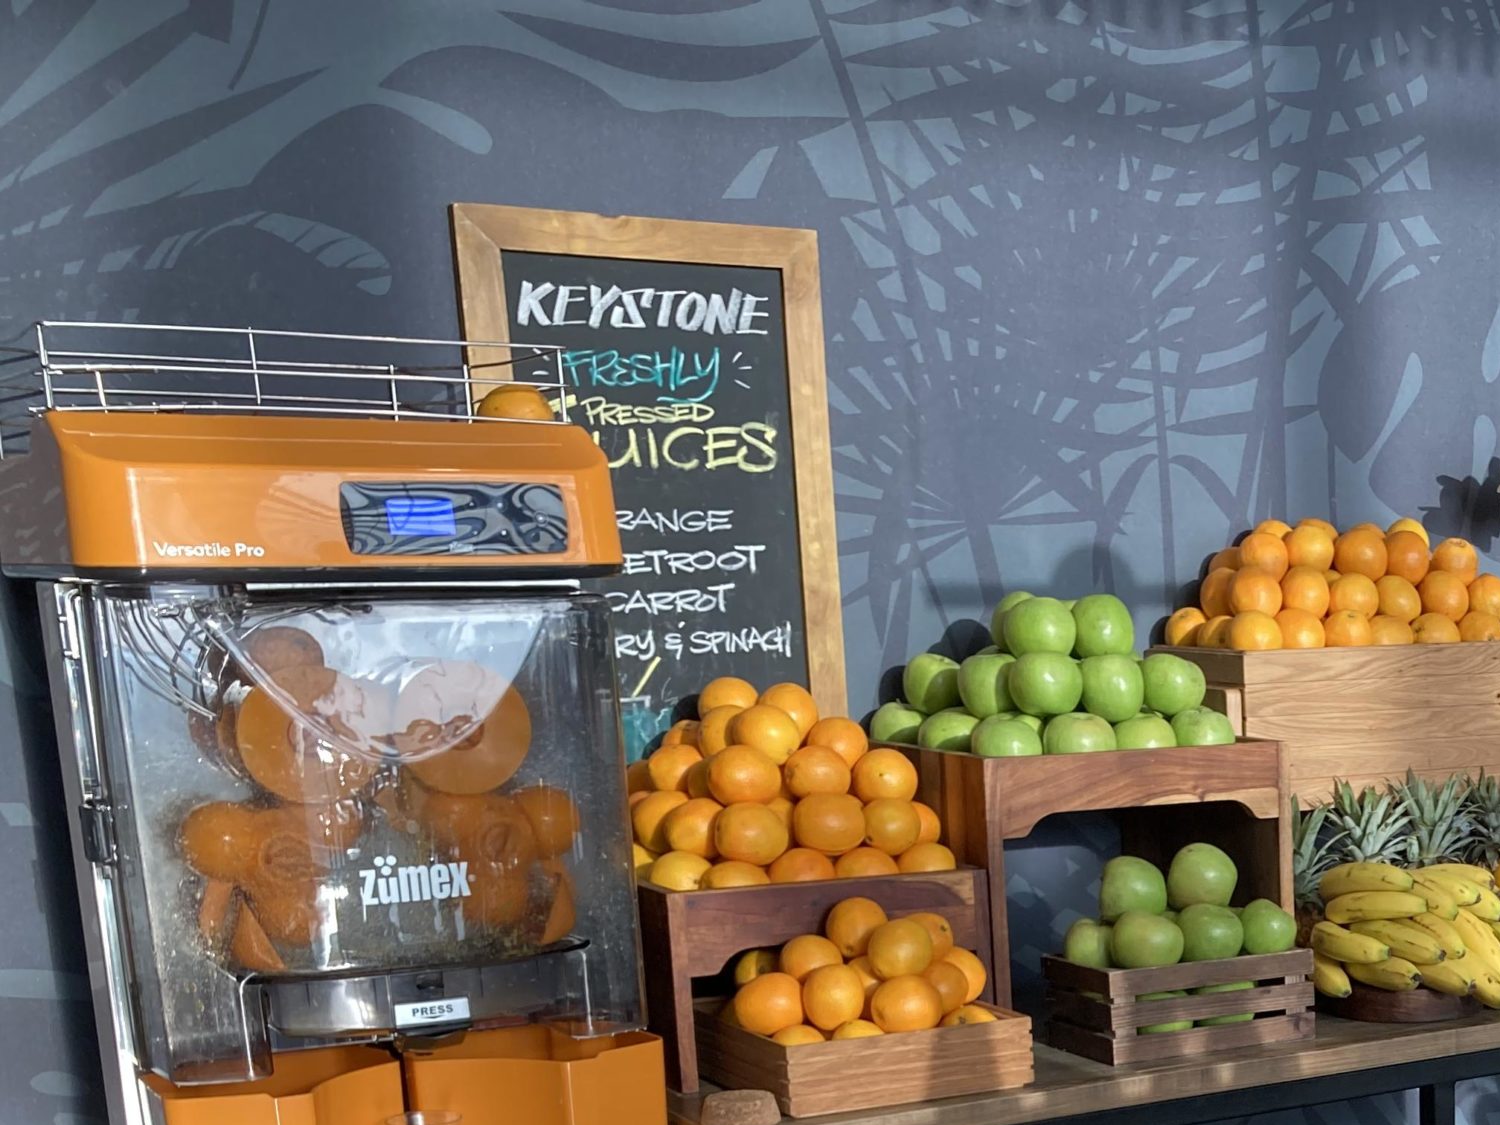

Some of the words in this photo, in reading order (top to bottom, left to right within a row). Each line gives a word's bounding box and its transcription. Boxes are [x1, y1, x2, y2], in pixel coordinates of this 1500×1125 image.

[517, 280, 769, 335] KEYSTONE
[561, 346, 721, 403] FRESHLY
[580, 396, 715, 426] PRESSED
[614, 507, 734, 532] RANGE
[153, 541, 231, 557] Versatile
[235, 542, 265, 557] Pro
[622, 545, 766, 575] ETROOT
[605, 583, 735, 615] CARROT
[690, 621, 792, 657] SPINACH
[412, 1004, 454, 1017] PRESS
